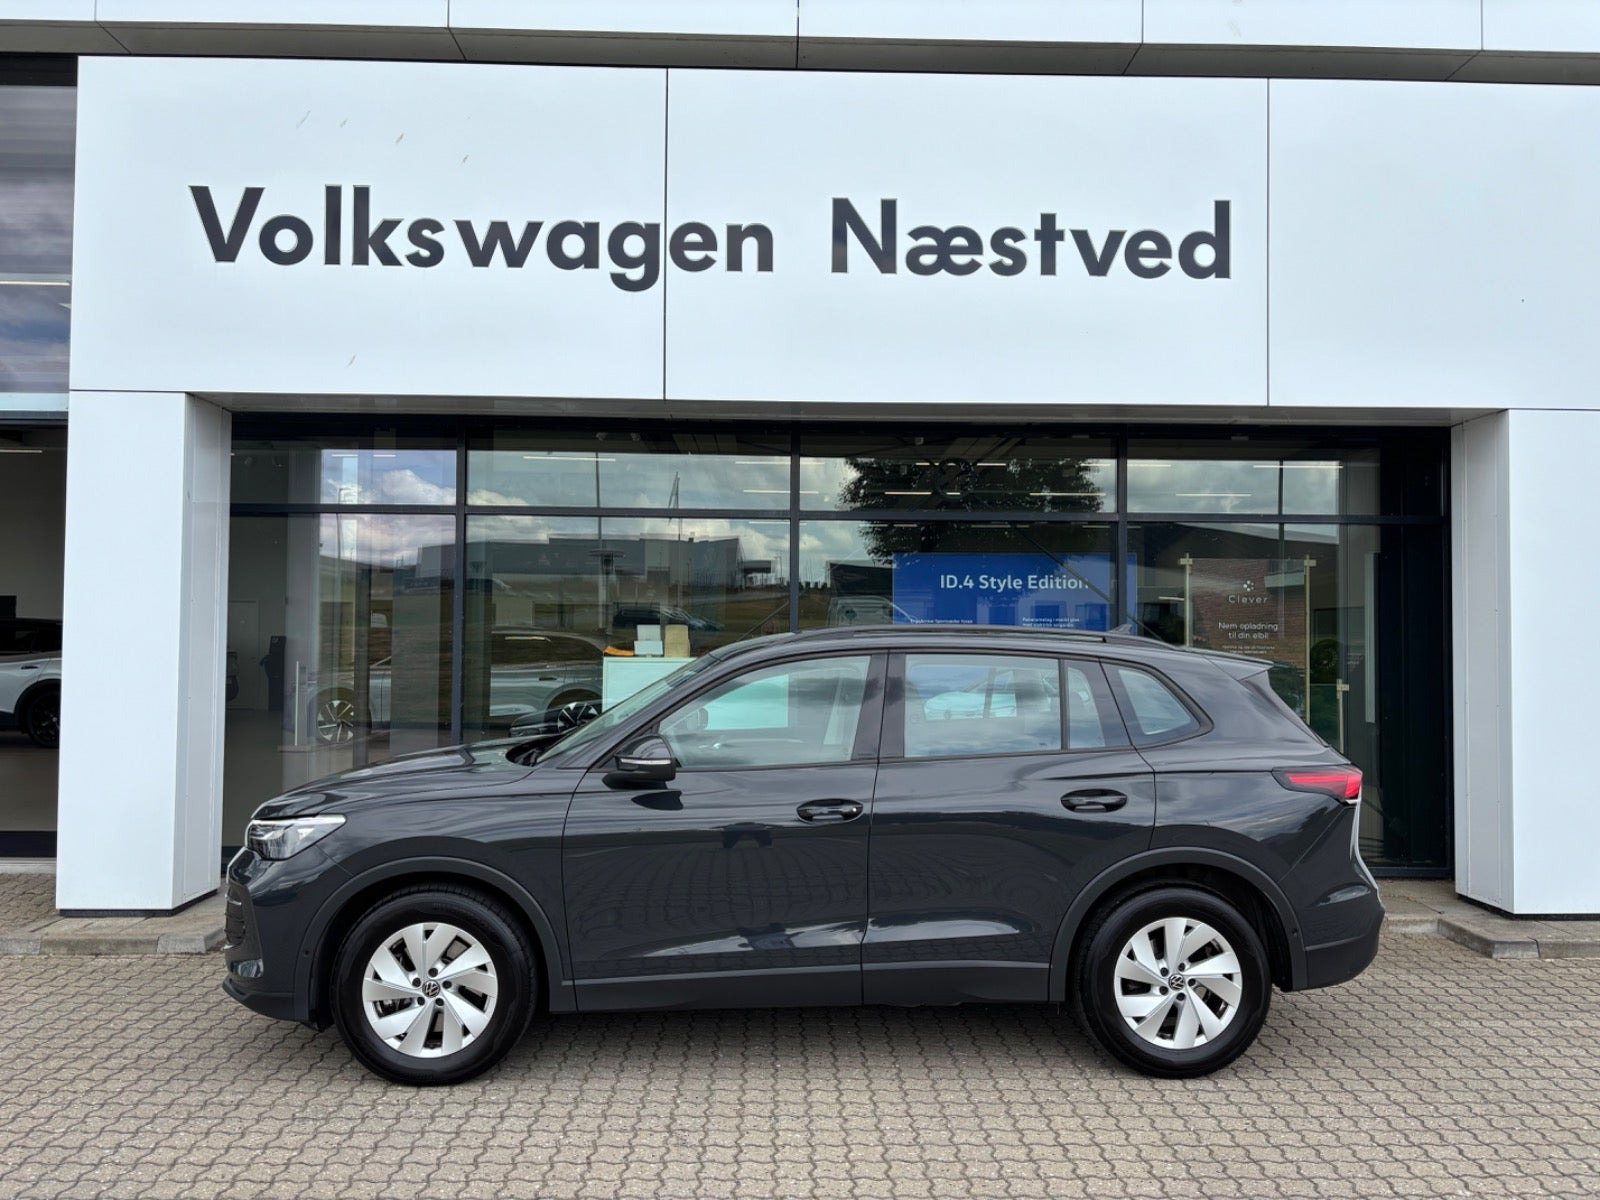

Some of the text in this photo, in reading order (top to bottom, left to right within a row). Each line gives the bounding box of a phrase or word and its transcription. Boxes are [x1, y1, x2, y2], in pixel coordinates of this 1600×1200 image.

[189, 184, 1232, 293] Volkswagen Næstved
[939, 574, 975, 590] ID.4
[979, 574, 1023, 593] Style
[1228, 594, 1269, 604] Clever
[1218, 621, 1279, 632] Nem opladning
